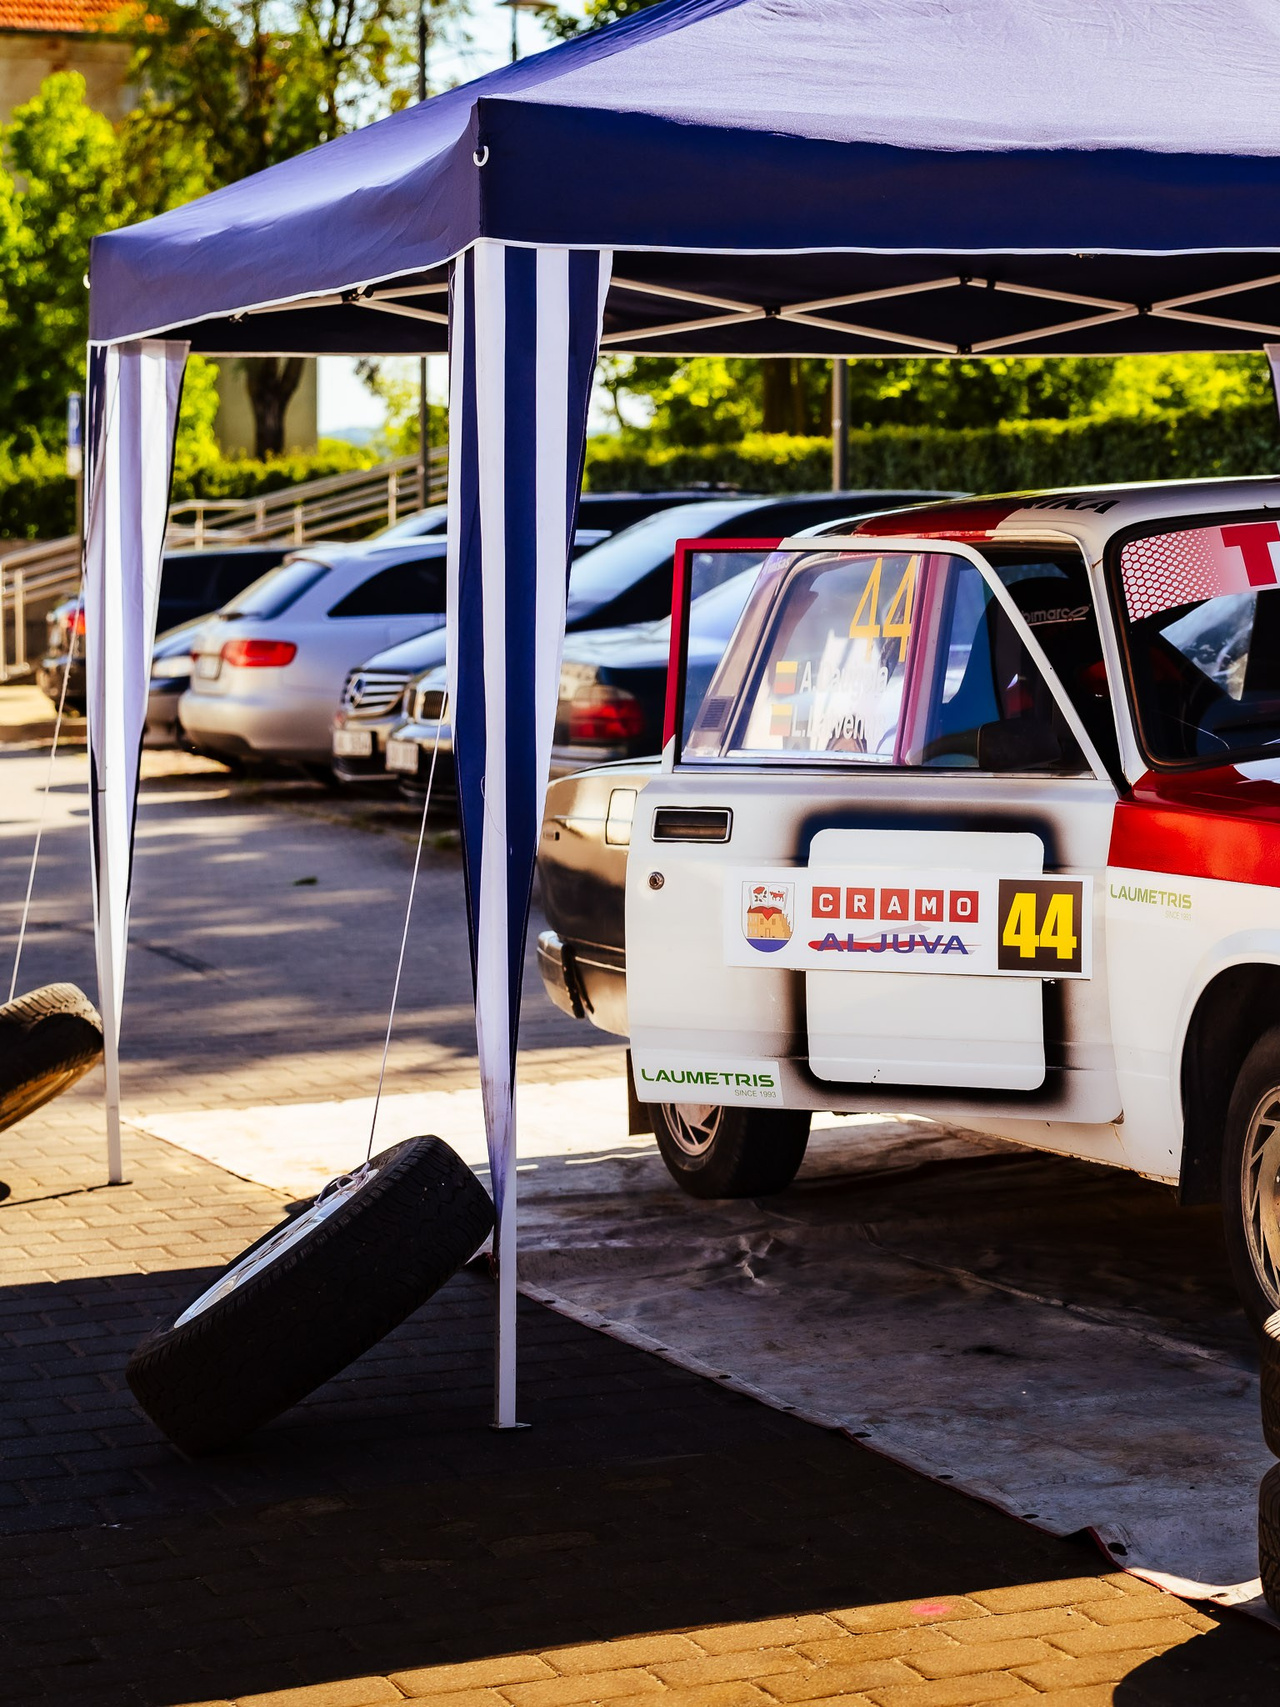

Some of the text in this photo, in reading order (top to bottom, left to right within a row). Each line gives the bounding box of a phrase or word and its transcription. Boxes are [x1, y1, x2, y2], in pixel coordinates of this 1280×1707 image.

[849, 555, 918, 663] 44
[819, 892, 973, 917] CRAMO
[1110, 884, 1192, 910] LAUMETRIS
[1002, 892, 1078, 960] 44
[817, 932, 970, 955] ALJUVA
[641, 1068, 775, 1088] LAUMETRIS
[734, 1089, 777, 1099] SINCE 1993
